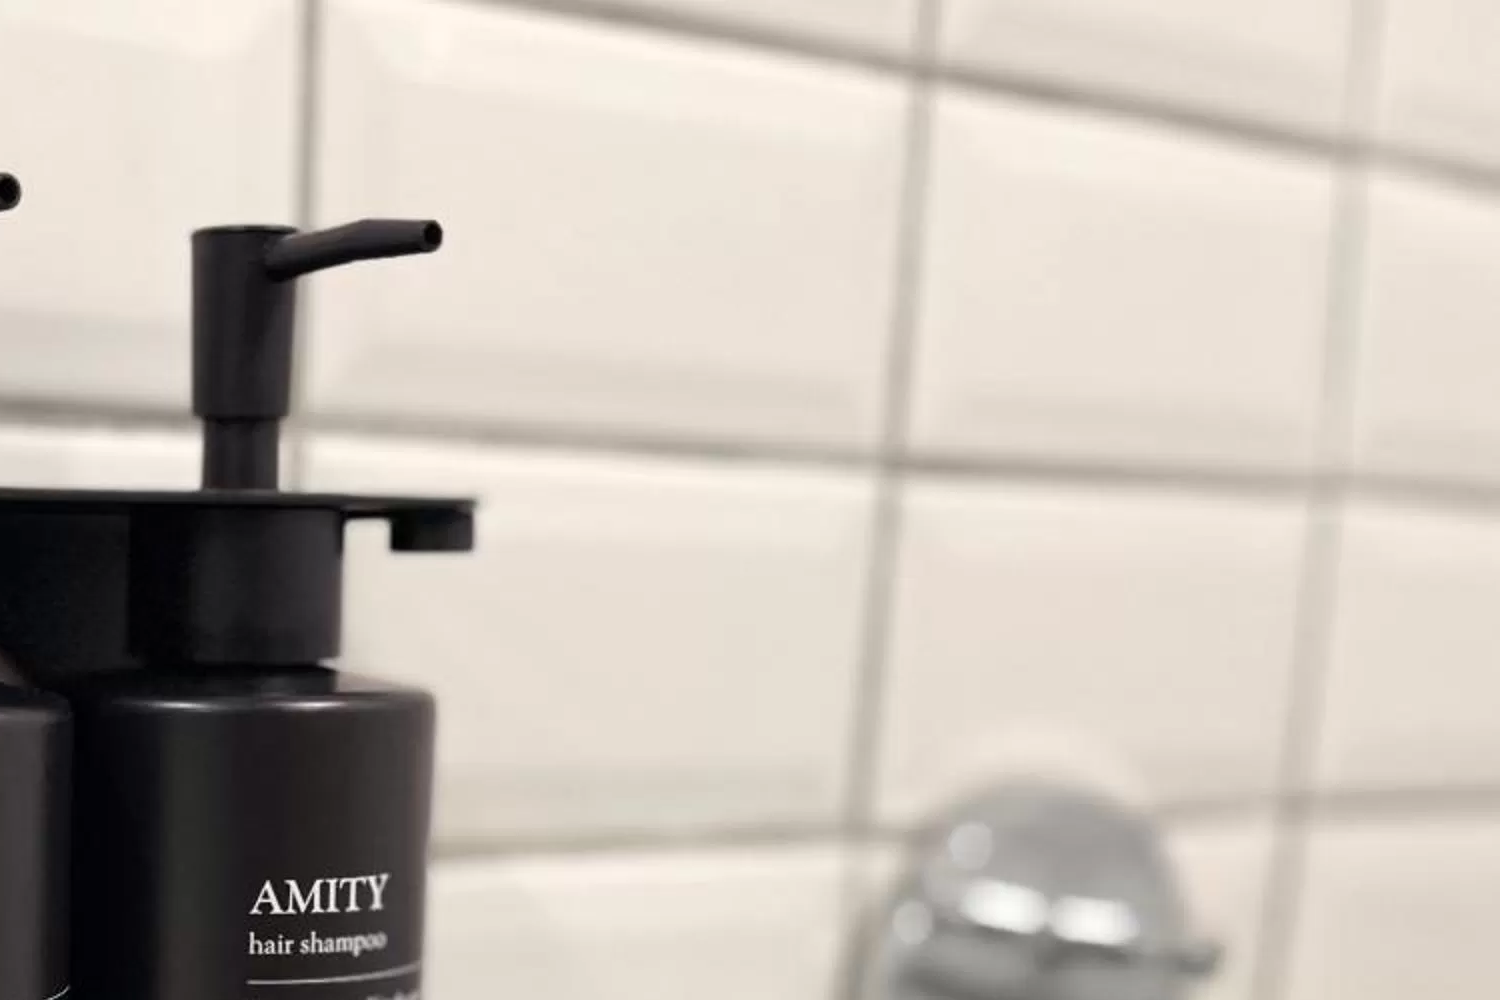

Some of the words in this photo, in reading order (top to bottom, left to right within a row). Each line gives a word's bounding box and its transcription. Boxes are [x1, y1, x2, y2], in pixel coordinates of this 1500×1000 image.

[249, 873, 391, 915] AMITY
[249, 932, 294, 955] hair
[300, 931, 388, 957] shampoo
